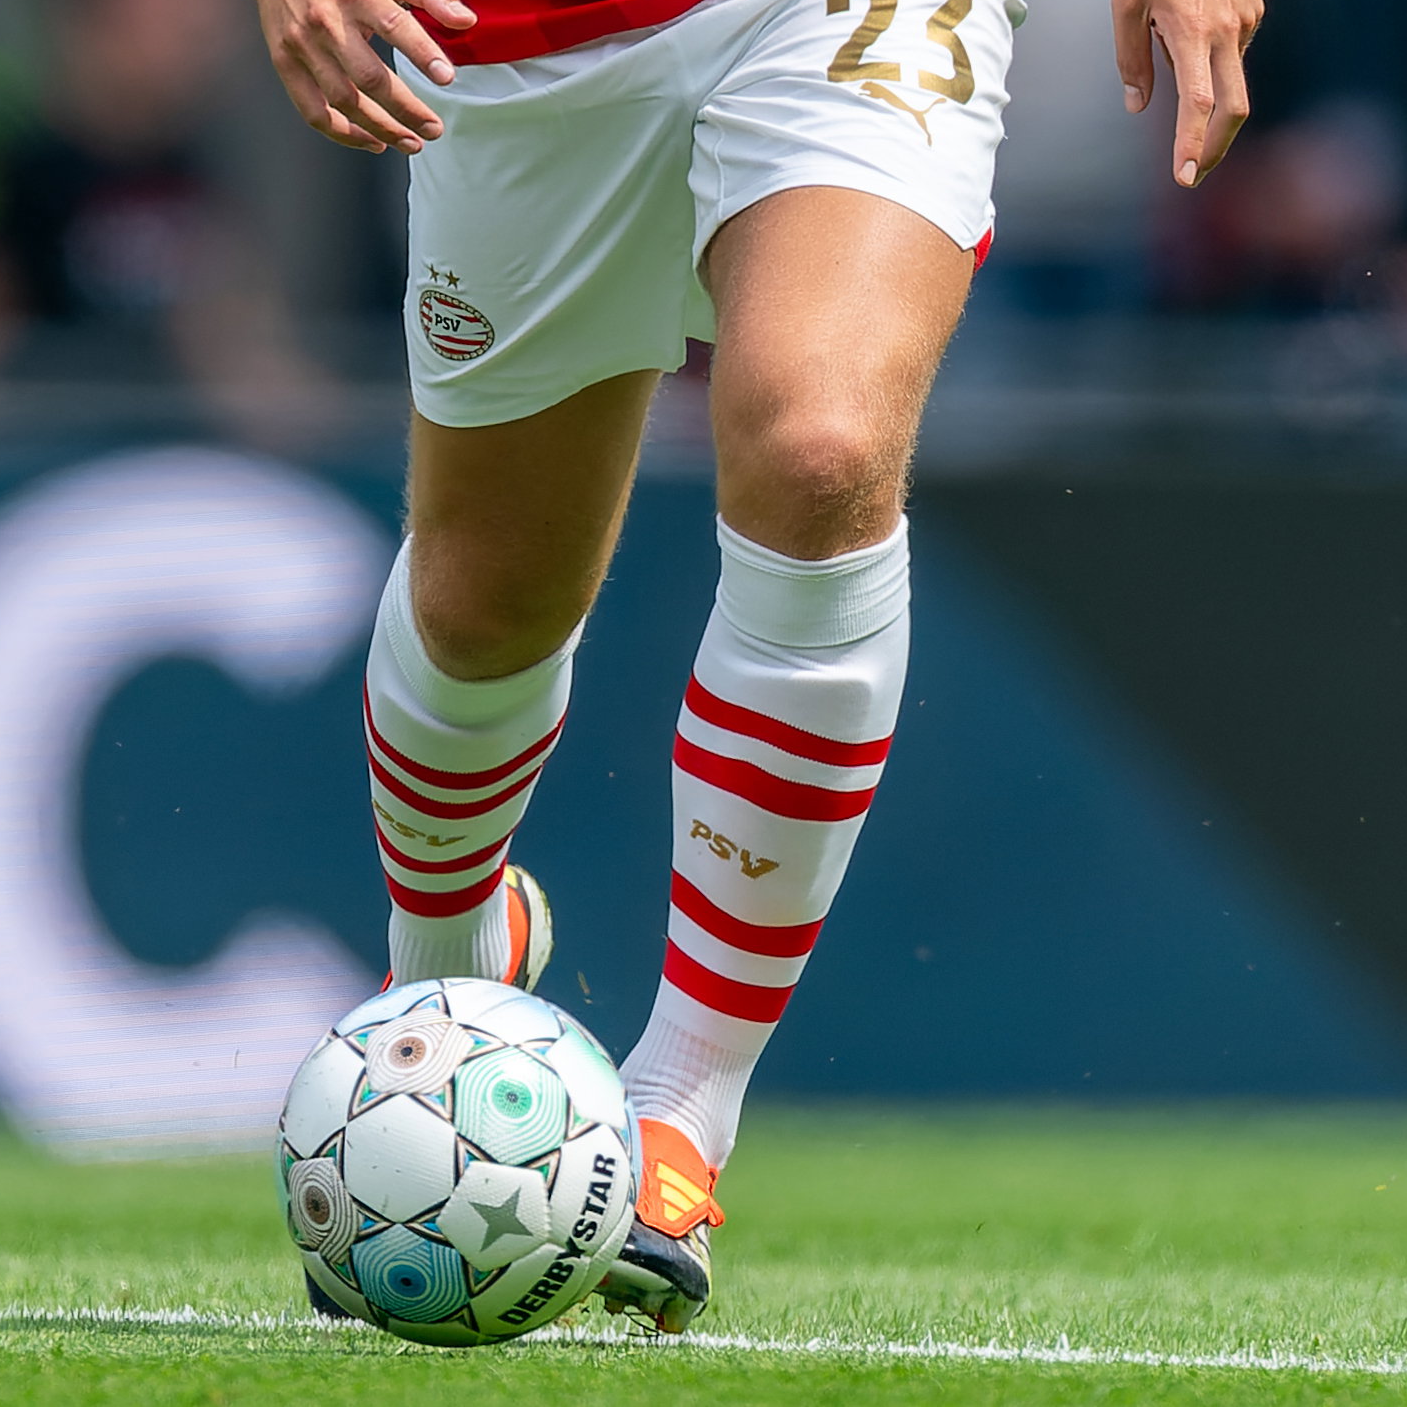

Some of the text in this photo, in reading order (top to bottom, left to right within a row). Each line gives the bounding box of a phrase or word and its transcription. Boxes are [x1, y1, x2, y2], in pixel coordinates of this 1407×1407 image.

[434, 313, 461, 332] PSV
[373, 799, 467, 847] PSV
[690, 819, 780, 880] PSV
[498, 1153, 616, 1325] DERBYSTAR
